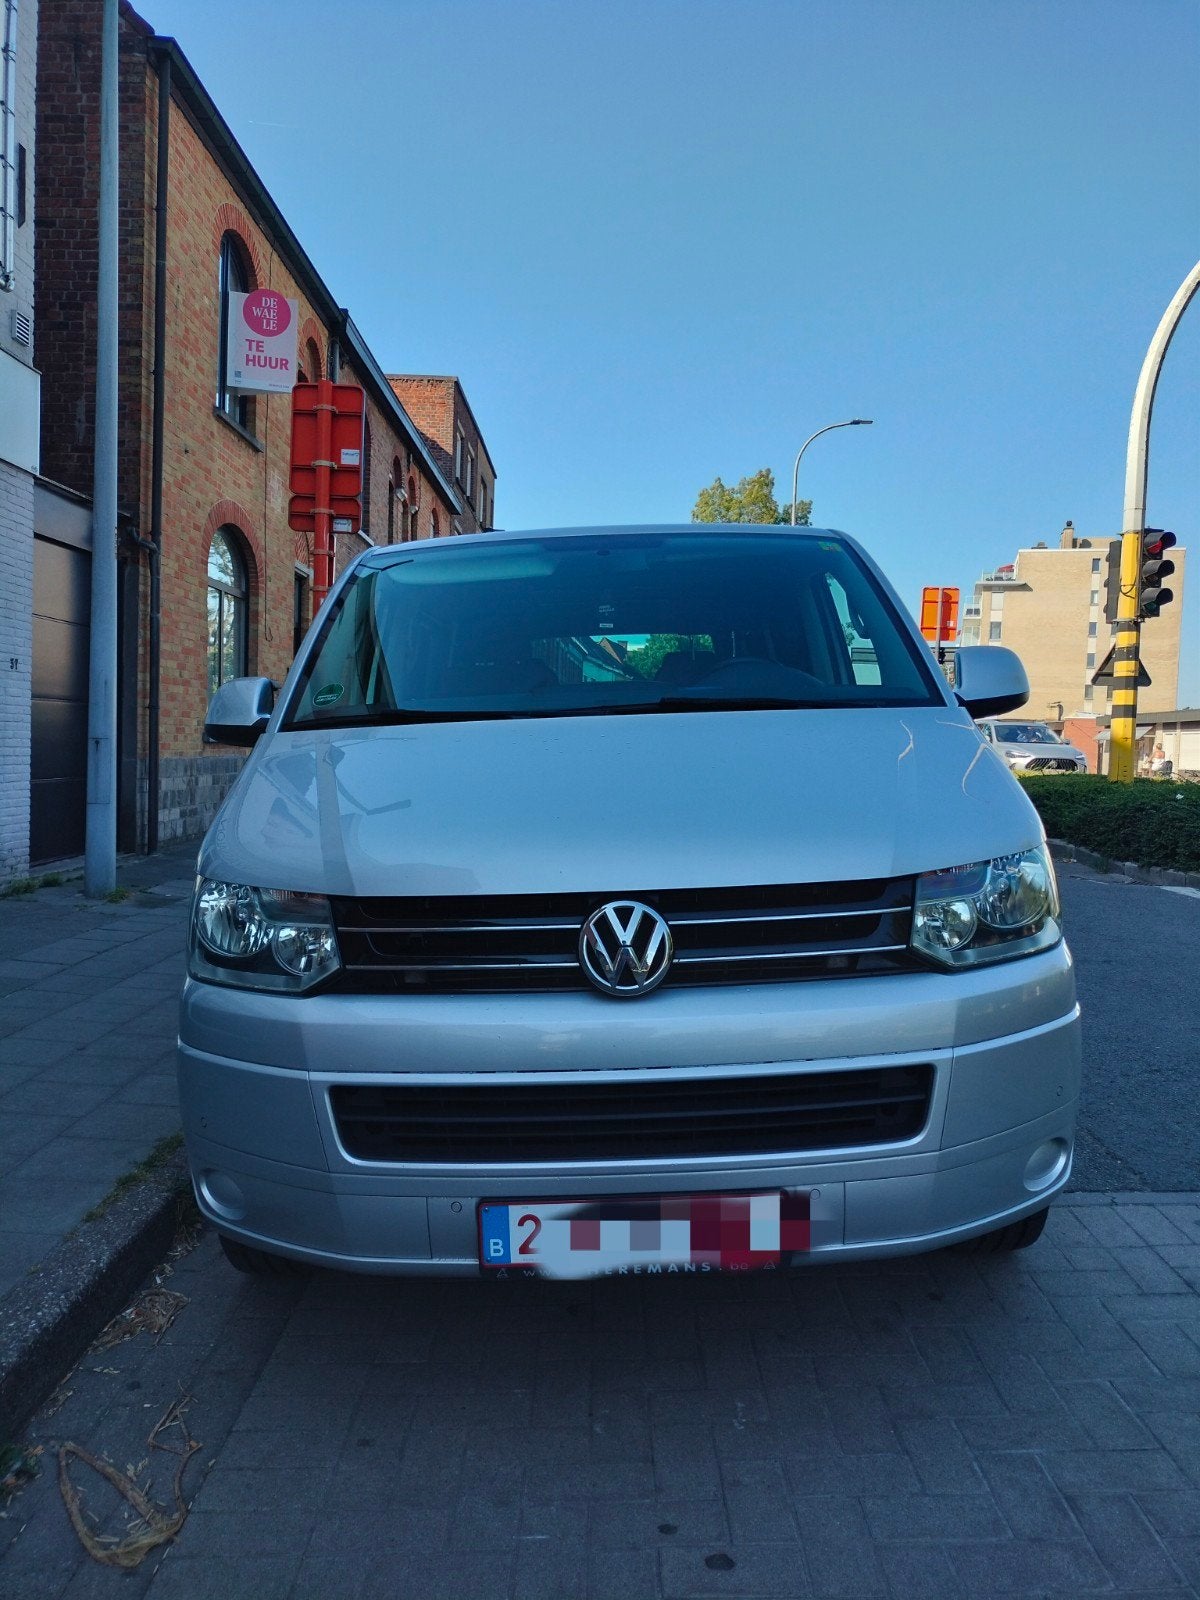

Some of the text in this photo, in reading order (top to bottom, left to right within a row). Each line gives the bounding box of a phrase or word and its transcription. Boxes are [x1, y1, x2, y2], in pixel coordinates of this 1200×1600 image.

[262, 297, 278, 309] DE
[252, 306, 278, 320] WAE
[262, 319, 278, 331] LE
[245, 338, 265, 353] TE
[245, 353, 290, 371] HUUR
[489, 1238, 504, 1257] B
